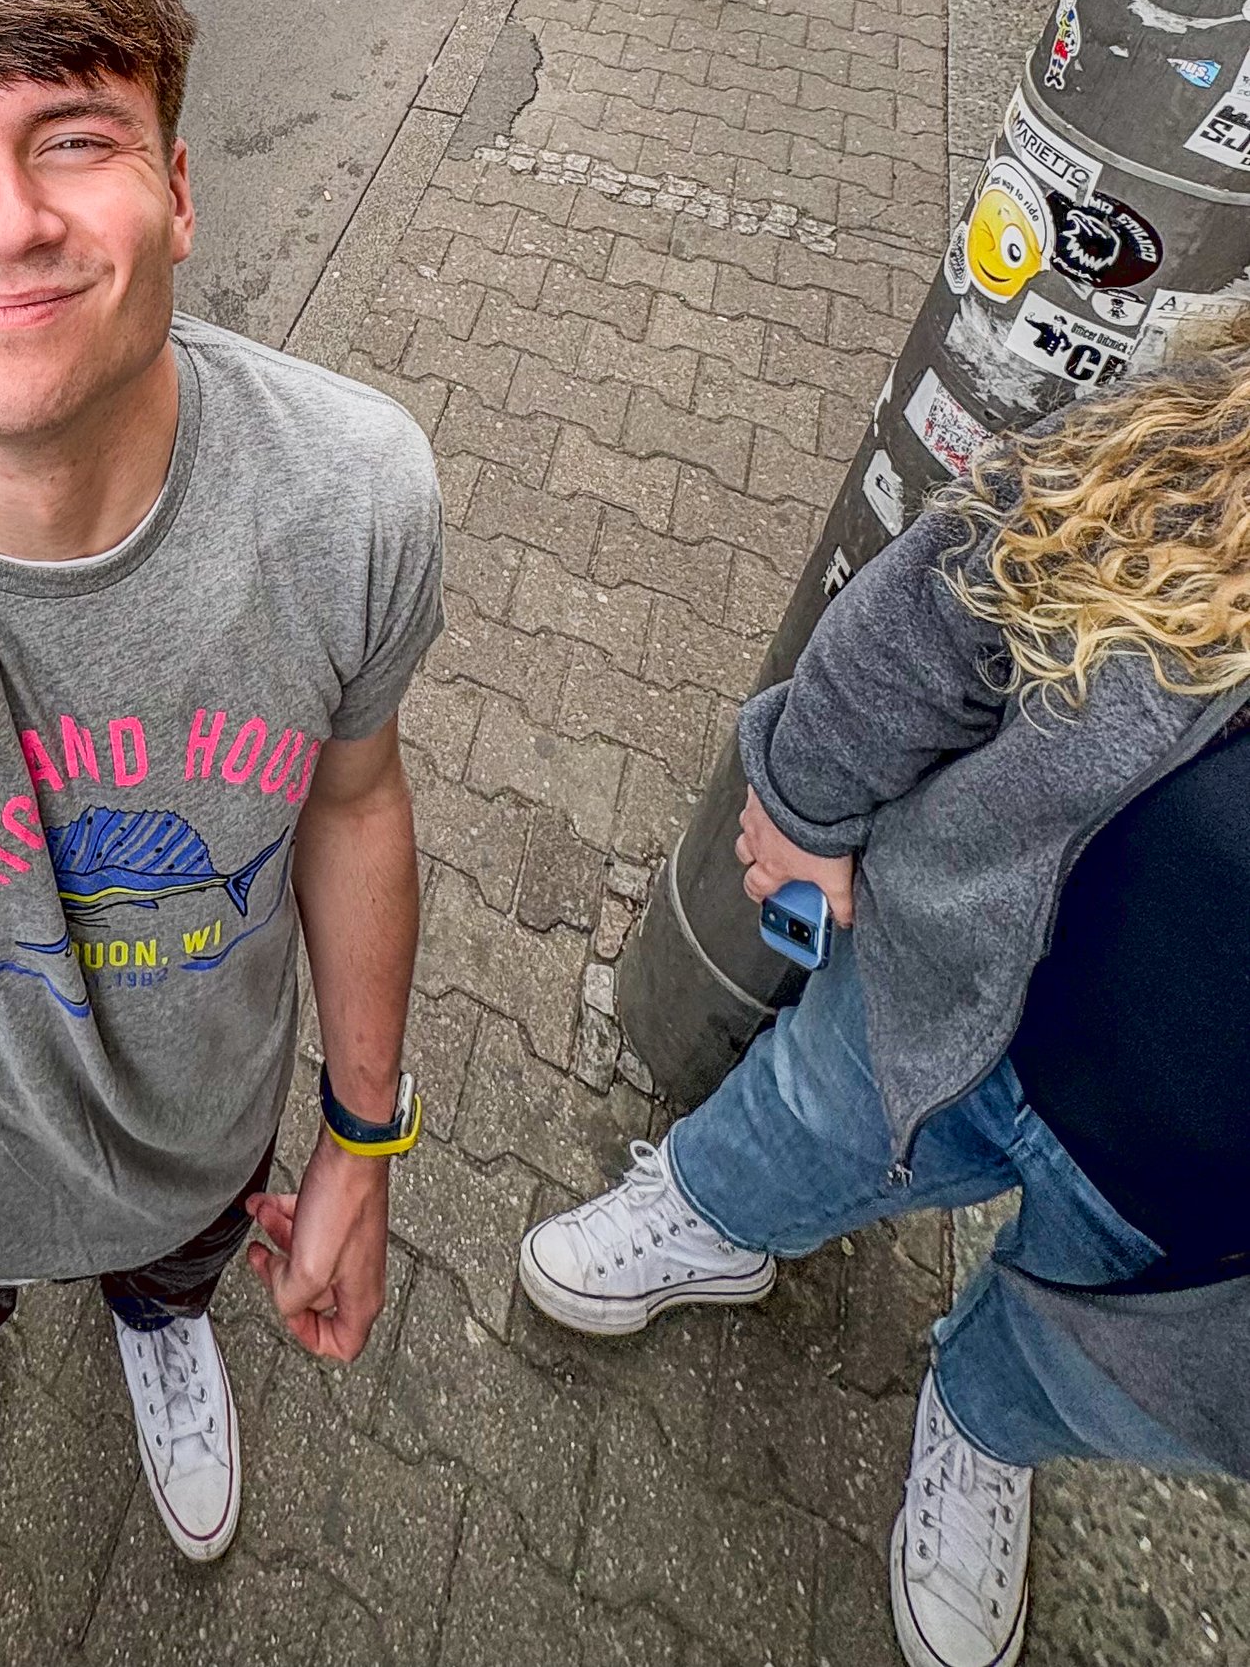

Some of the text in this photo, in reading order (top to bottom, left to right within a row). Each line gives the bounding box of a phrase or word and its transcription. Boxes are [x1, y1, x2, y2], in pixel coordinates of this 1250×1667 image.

[1015, 111, 1090, 189] MARIETTO
[1024, 201, 1039, 222] ride
[182, 920, 222, 954] WI
